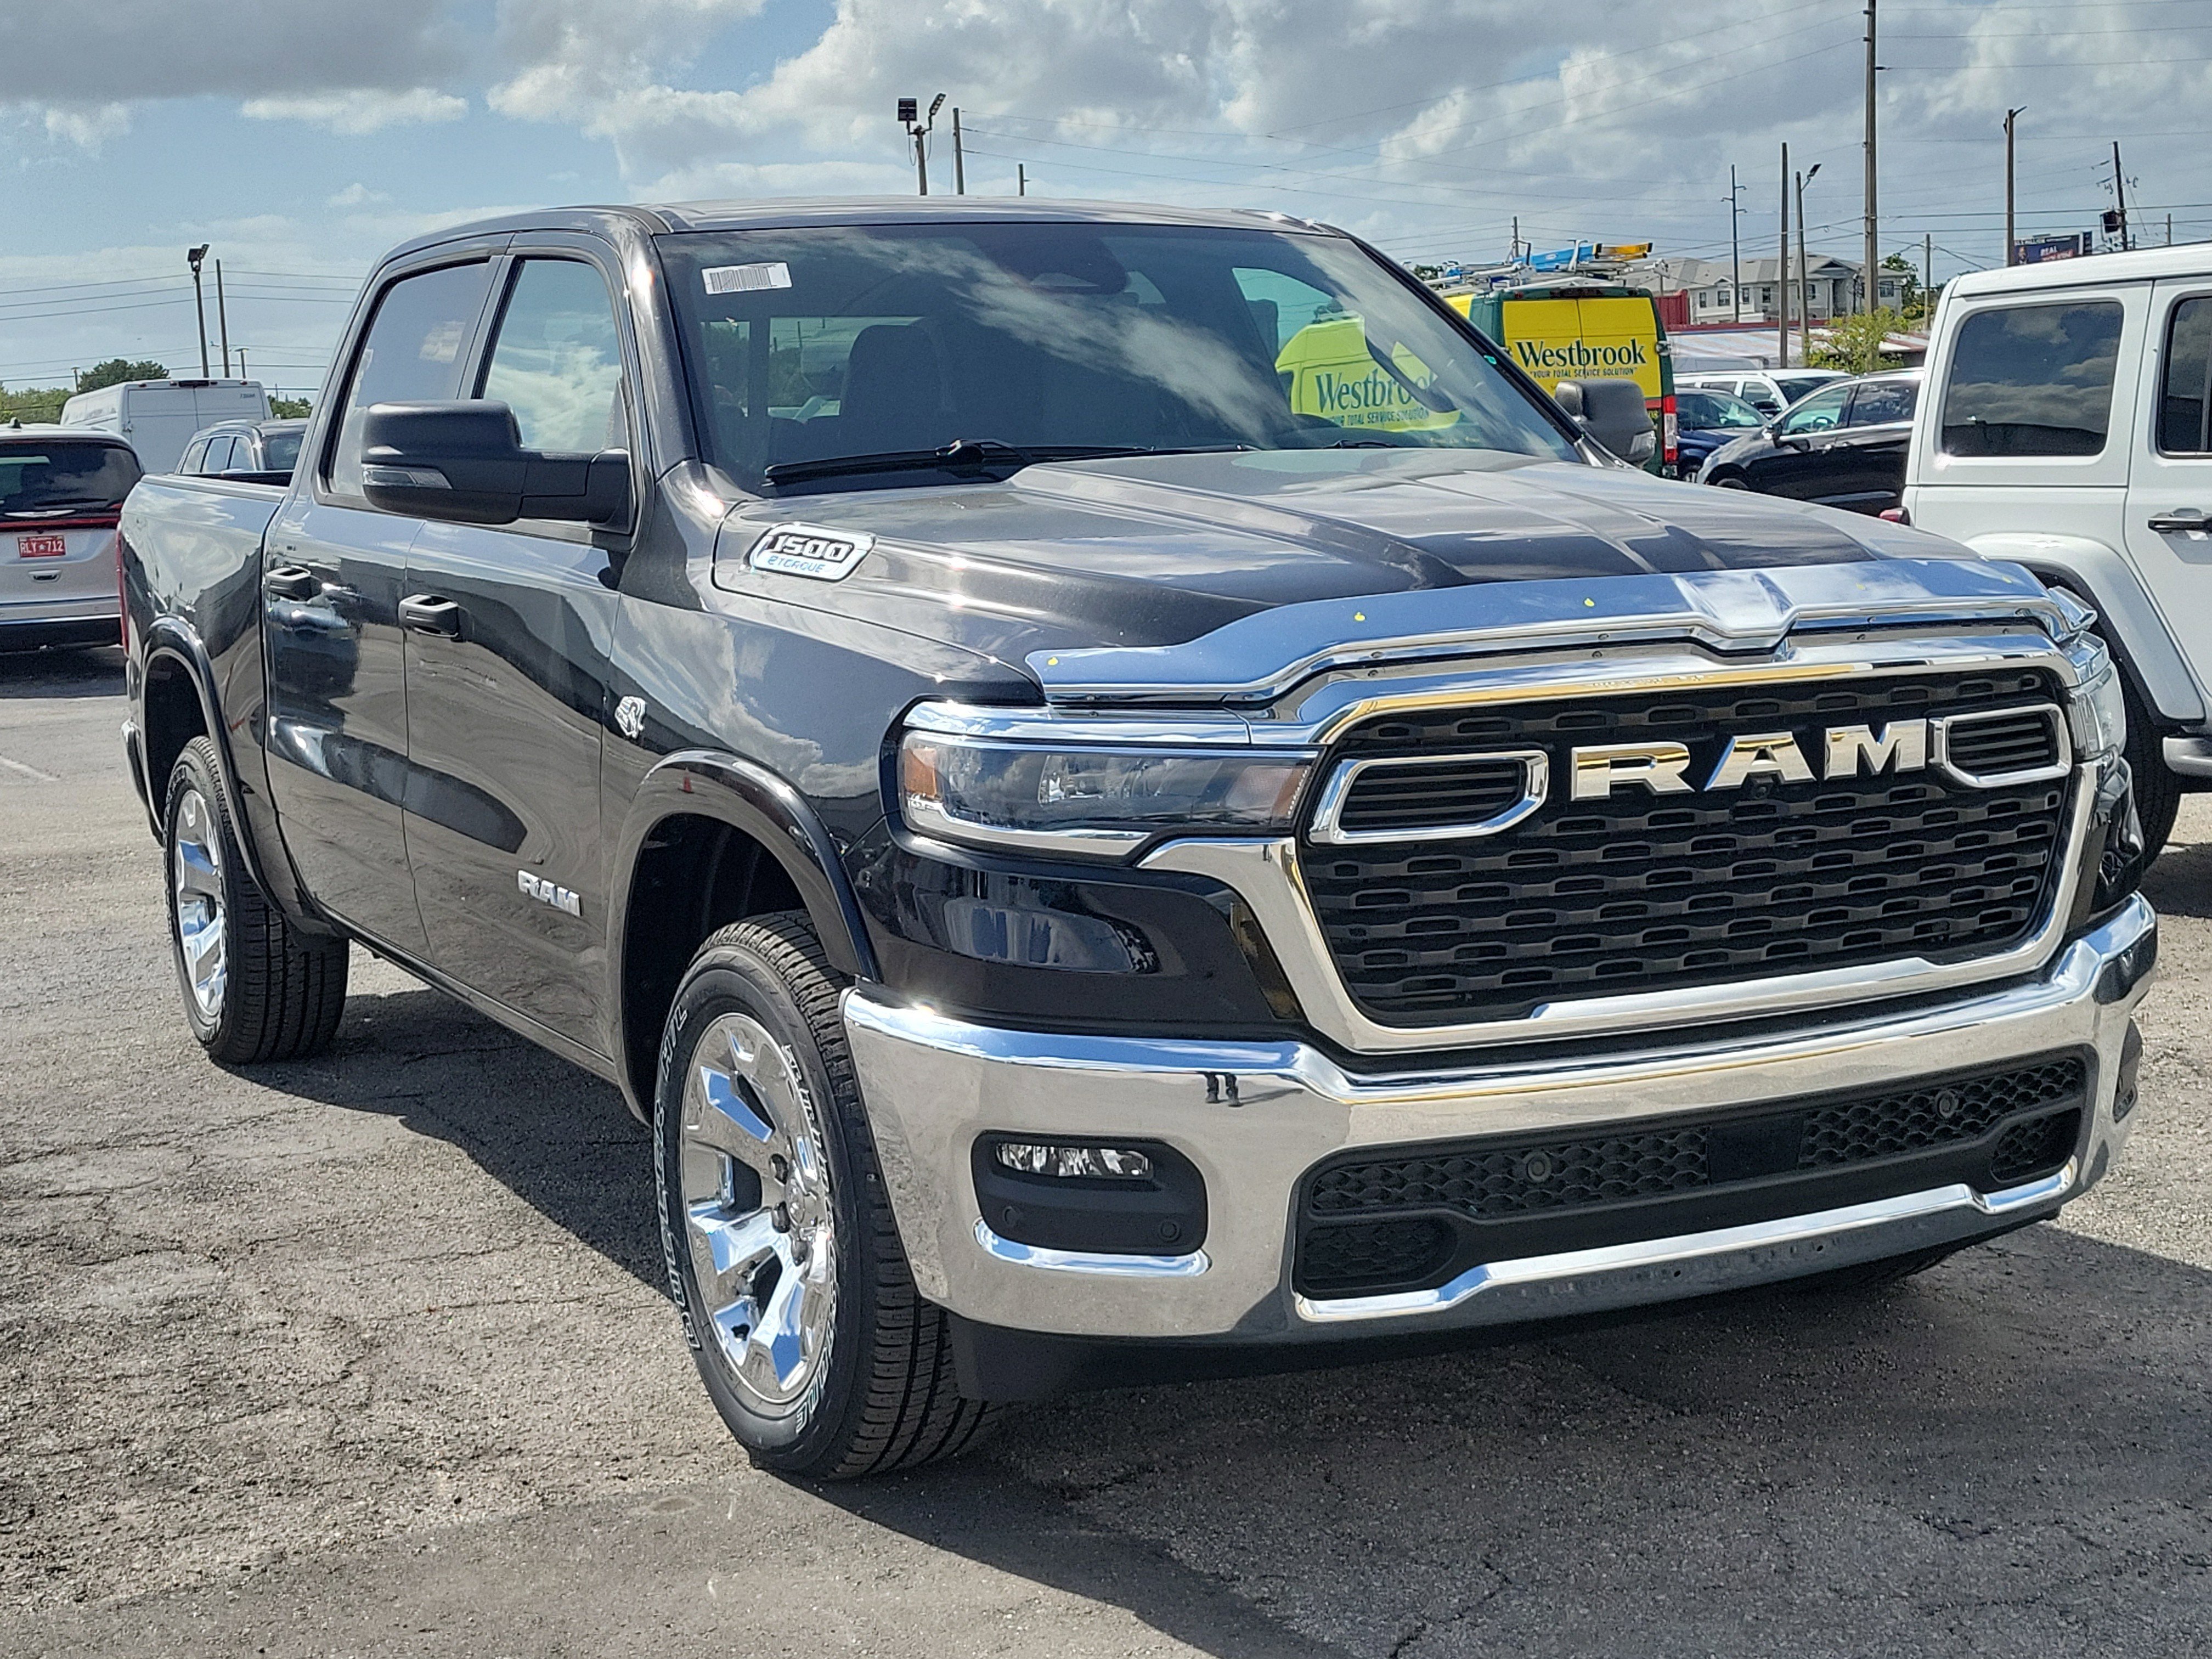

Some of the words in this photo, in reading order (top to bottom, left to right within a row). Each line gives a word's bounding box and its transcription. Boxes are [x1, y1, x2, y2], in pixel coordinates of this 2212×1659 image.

[1515, 338, 1646, 368] Westbrook
[1316, 368, 1436, 413] Westbroo
[1553, 369, 1571, 377] TOTAL
[1574, 369, 1600, 377] SERVICE
[771, 534, 853, 561] 1500
[1570, 718, 1927, 802] RAM
[518, 870, 582, 917] RAM
